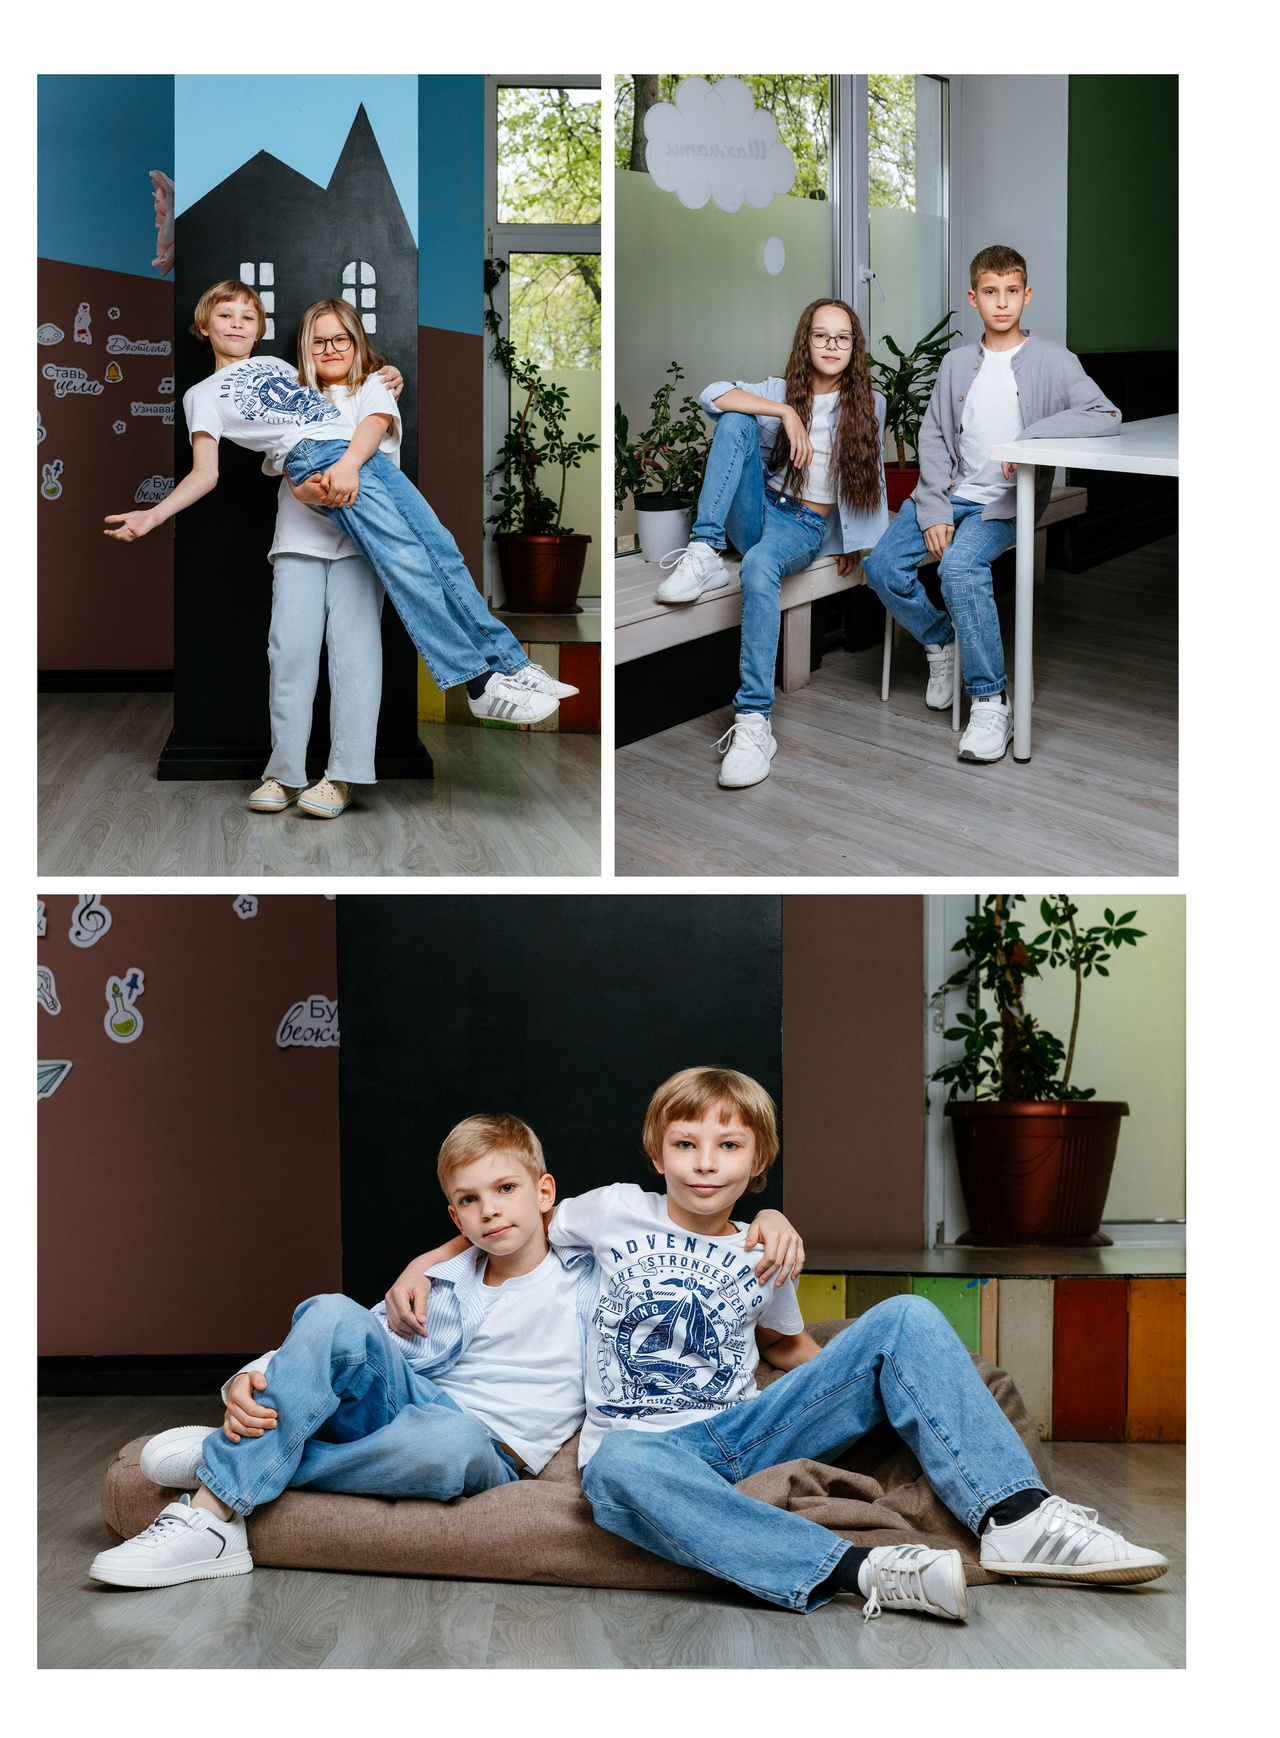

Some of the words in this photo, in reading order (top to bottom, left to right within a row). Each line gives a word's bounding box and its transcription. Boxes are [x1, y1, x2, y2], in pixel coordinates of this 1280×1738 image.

[108, 337, 169, 354] Достигай
[44, 366, 87, 379] Ставь
[55, 379, 102, 396] цели
[136, 479, 167, 501] веж
[310, 999, 338, 1023] Бу
[610, 1233, 762, 1307] ADVENTURES
[610, 1267, 635, 1287] THE
[646, 1254, 736, 1295] STRONGEST
[731, 1298, 748, 1324] CRE
[599, 1295, 624, 1313] WIND
